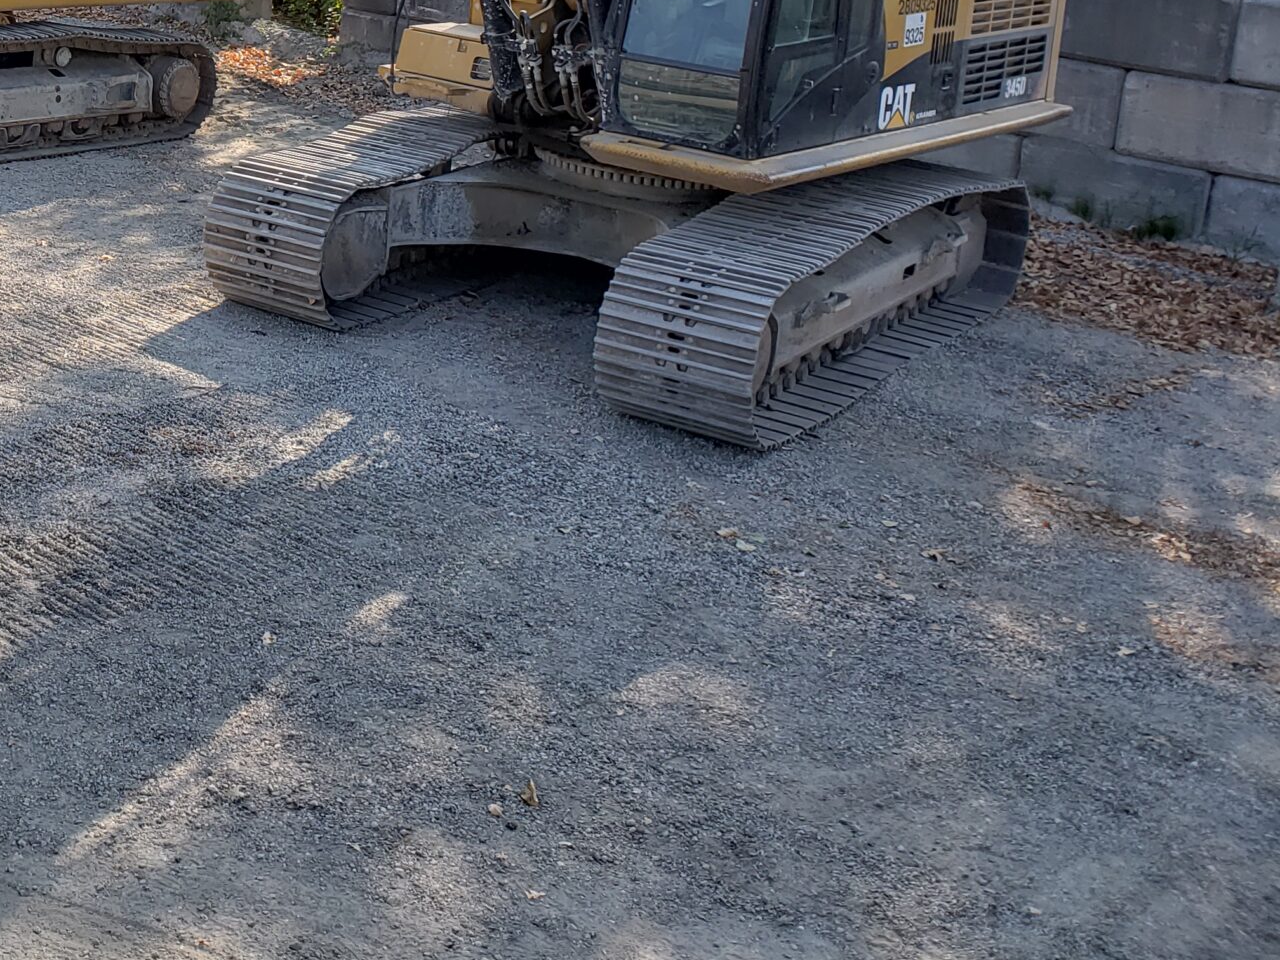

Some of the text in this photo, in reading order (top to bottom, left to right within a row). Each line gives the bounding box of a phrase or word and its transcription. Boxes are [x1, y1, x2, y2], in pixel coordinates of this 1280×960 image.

[904, 27, 924, 45] 9325
[1004, 76, 1027, 98] 345D
[878, 83, 917, 130] CAT
